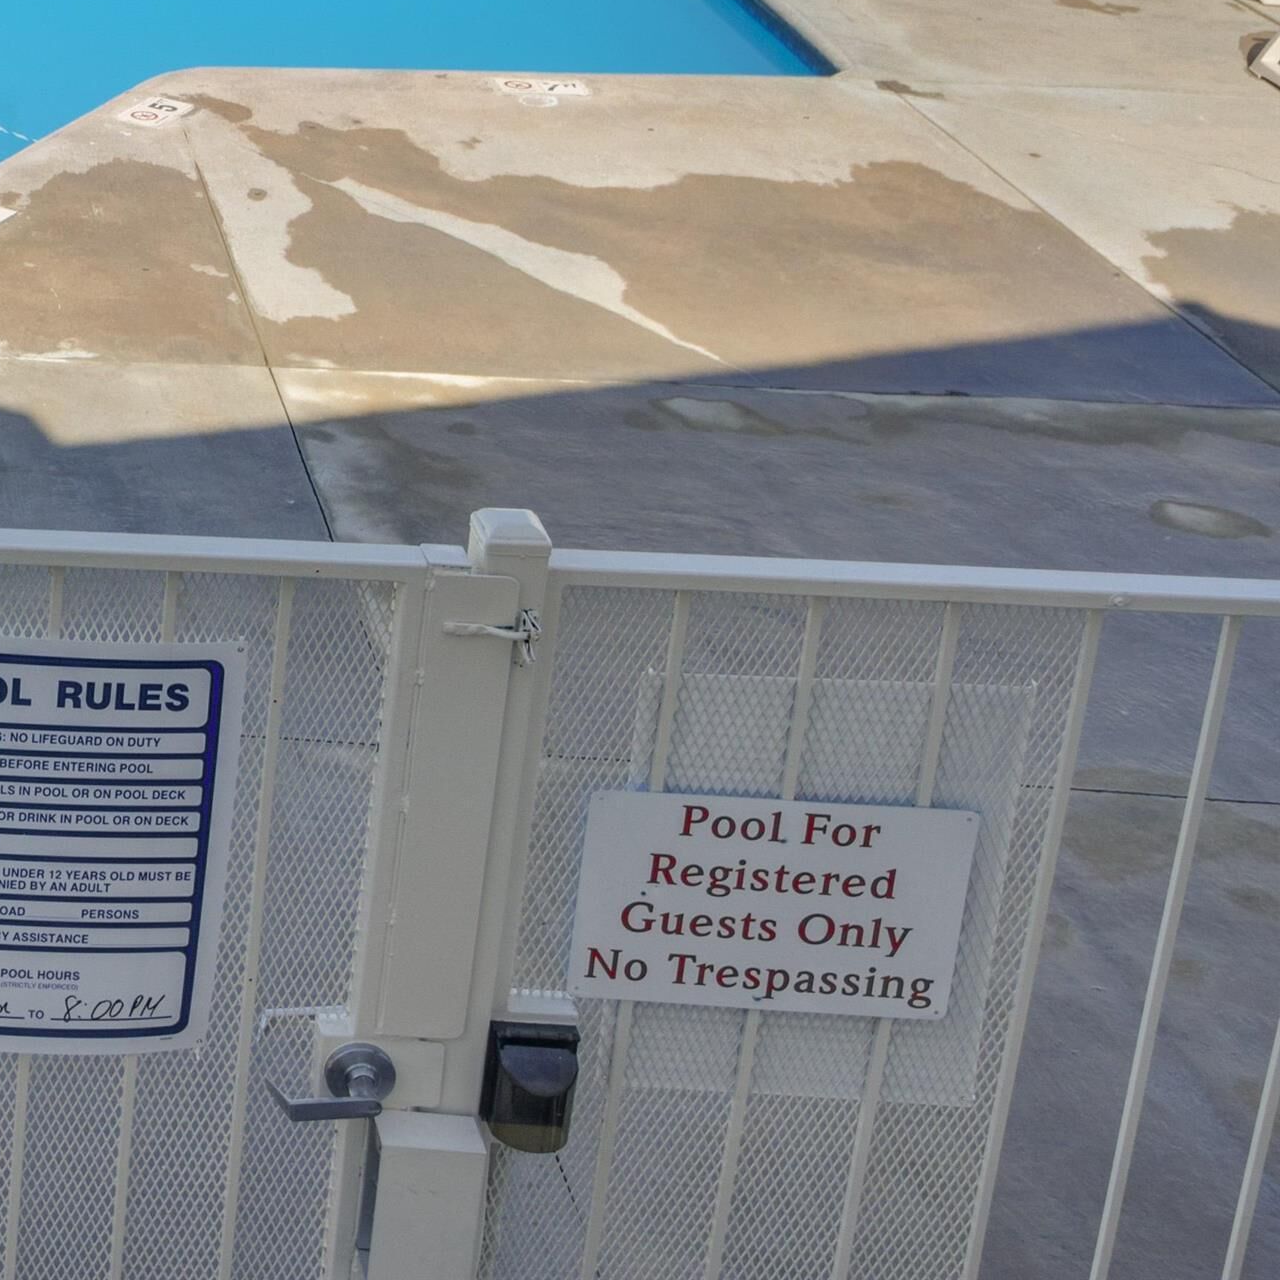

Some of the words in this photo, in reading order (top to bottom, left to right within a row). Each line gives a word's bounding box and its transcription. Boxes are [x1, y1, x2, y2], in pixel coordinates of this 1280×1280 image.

[56, 680, 190, 712] RULES
[10, 731, 27, 743] NO
[32, 733, 102, 746] LIFEGUARD
[106, 736, 124, 747] ON
[127, 737, 161, 748] DUTY
[0, 757, 50, 770] BEFORE
[53, 760, 116, 773] ENTERING
[119, 763, 153, 774] POOL
[19, 785, 31, 796] IN
[35, 786, 68, 798] POOL
[71, 788, 90, 798] OR
[93, 789, 111, 799] ON
[114, 789, 148, 800] POOL
[152, 790, 186, 801] DECK
[19, 811, 56, 823] DRINK
[60, 813, 72, 823] IN
[75, 814, 109, 825] POOL
[113, 815, 131, 825] OR
[133, 815, 151, 826] ON
[155, 816, 189, 826] DECK
[679, 804, 784, 843] Pool
[800, 813, 882, 848] For
[2, 867, 45, 879] UNDER
[49, 870, 62, 880] 12
[65, 870, 106, 881] YEARS
[109, 871, 135, 881] OLD
[138, 871, 173, 882] MUST
[175, 871, 191, 881] BE
[646, 852, 897, 900] Registered
[29, 880, 47, 891] BY
[49, 881, 67, 891] AN
[70, 882, 111, 893] ADULT
[81, 909, 140, 920] PERSONS
[620, 901, 778, 942] Guests
[798, 913, 913, 957] Only
[12, 931, 89, 944] ASSISTANCE
[0, 968, 33, 980] POOL
[37, 970, 81, 981] HOURS
[584, 947, 648, 982] No
[667, 952, 935, 1009] Trespassing
[28, 1009, 44, 1020] TO
